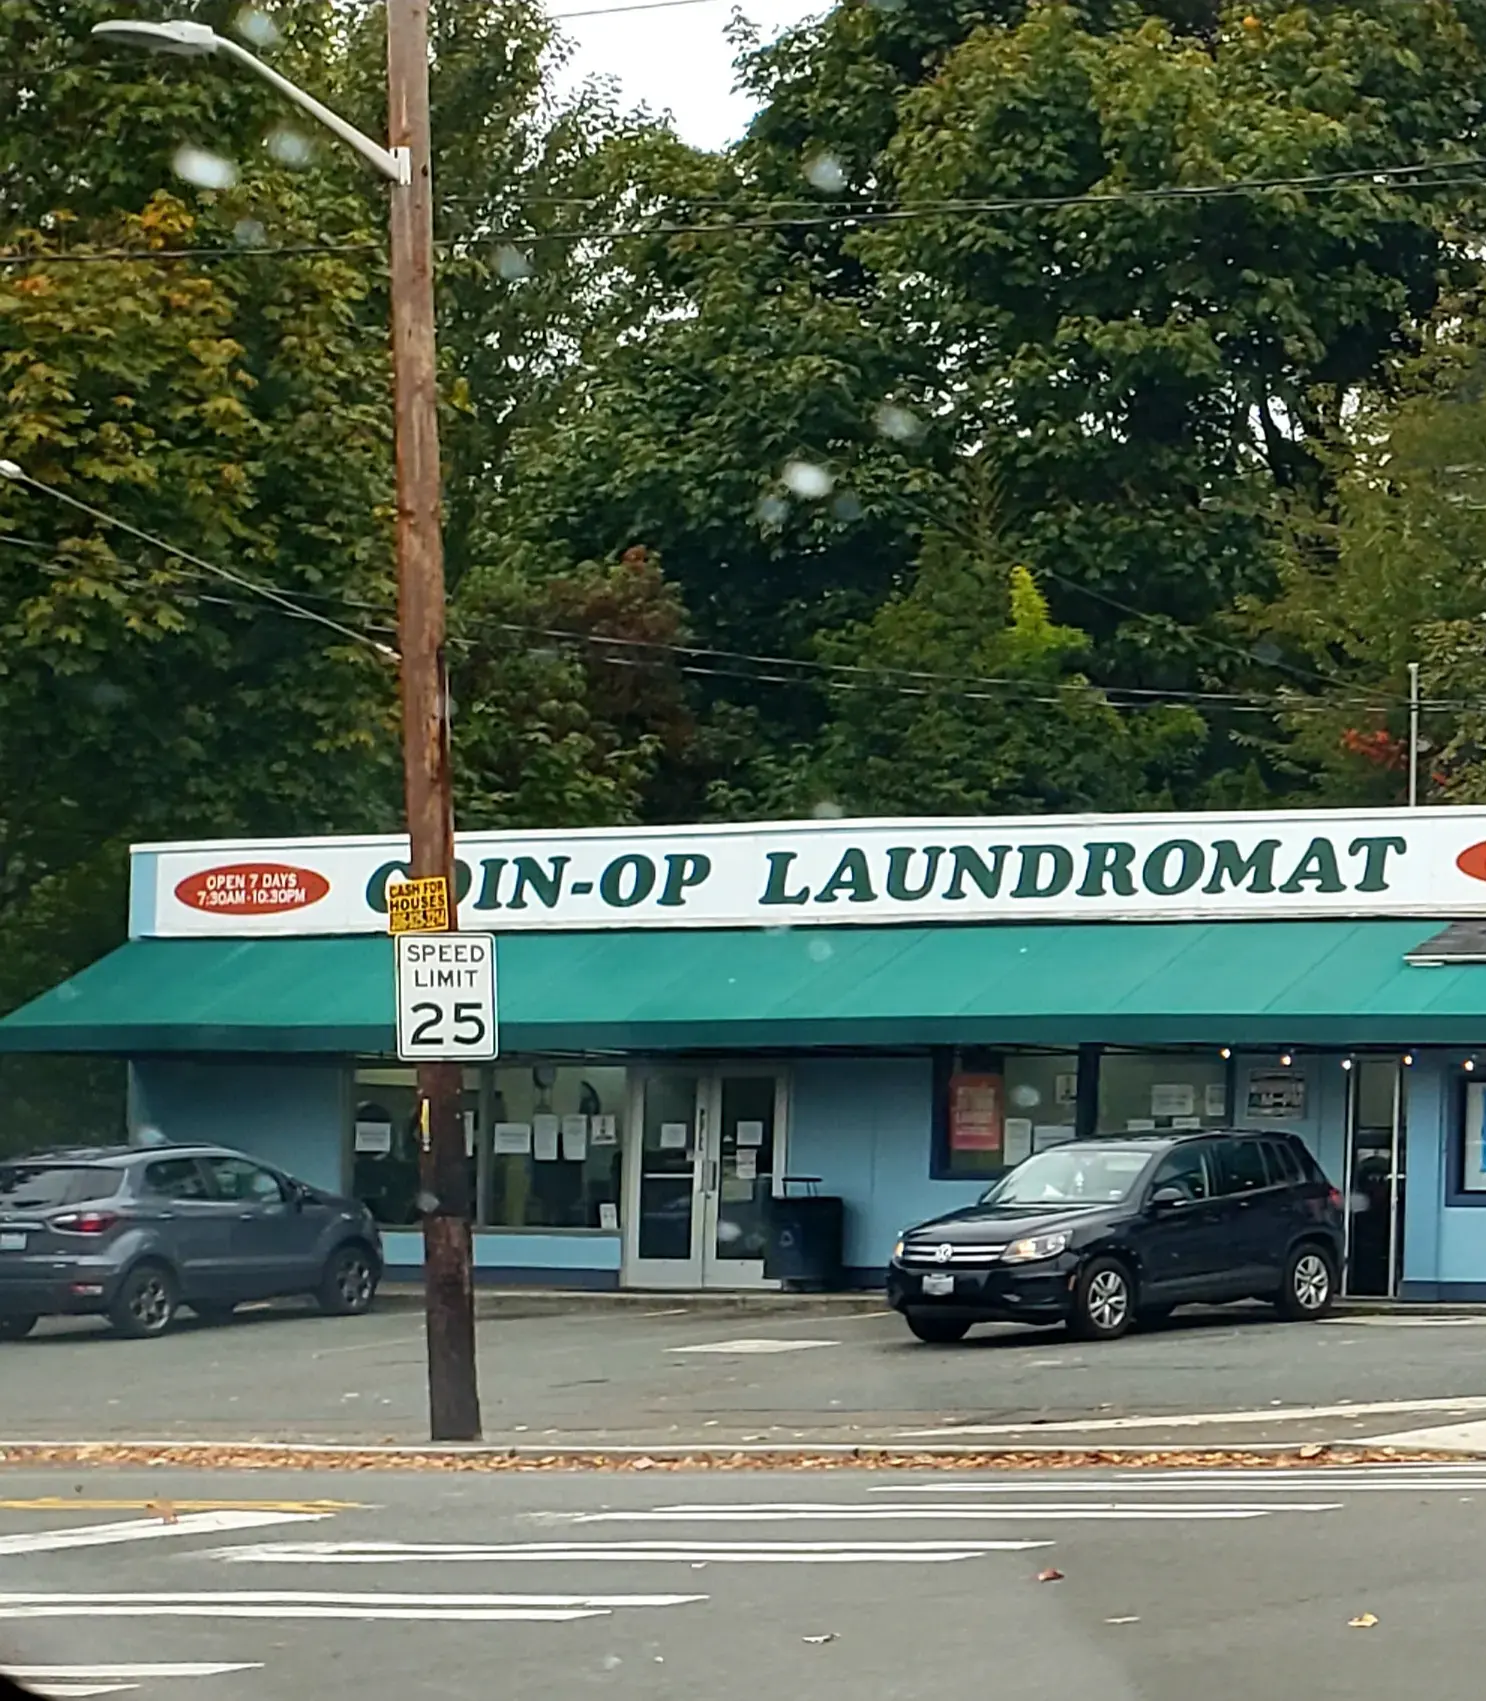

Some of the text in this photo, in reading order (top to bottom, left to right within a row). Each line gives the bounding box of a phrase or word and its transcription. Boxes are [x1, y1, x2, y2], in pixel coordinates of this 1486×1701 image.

[757, 836, 1408, 906] LAUNDROMAT
[206, 873, 298, 890] OPEN 7 DAYS
[389, 880, 444, 899] CASH FOR
[389, 894, 446, 912] HOUSES
[407, 943, 485, 963] SPEED
[413, 968, 479, 988] LIMIT
[410, 1001, 486, 1046] 25
